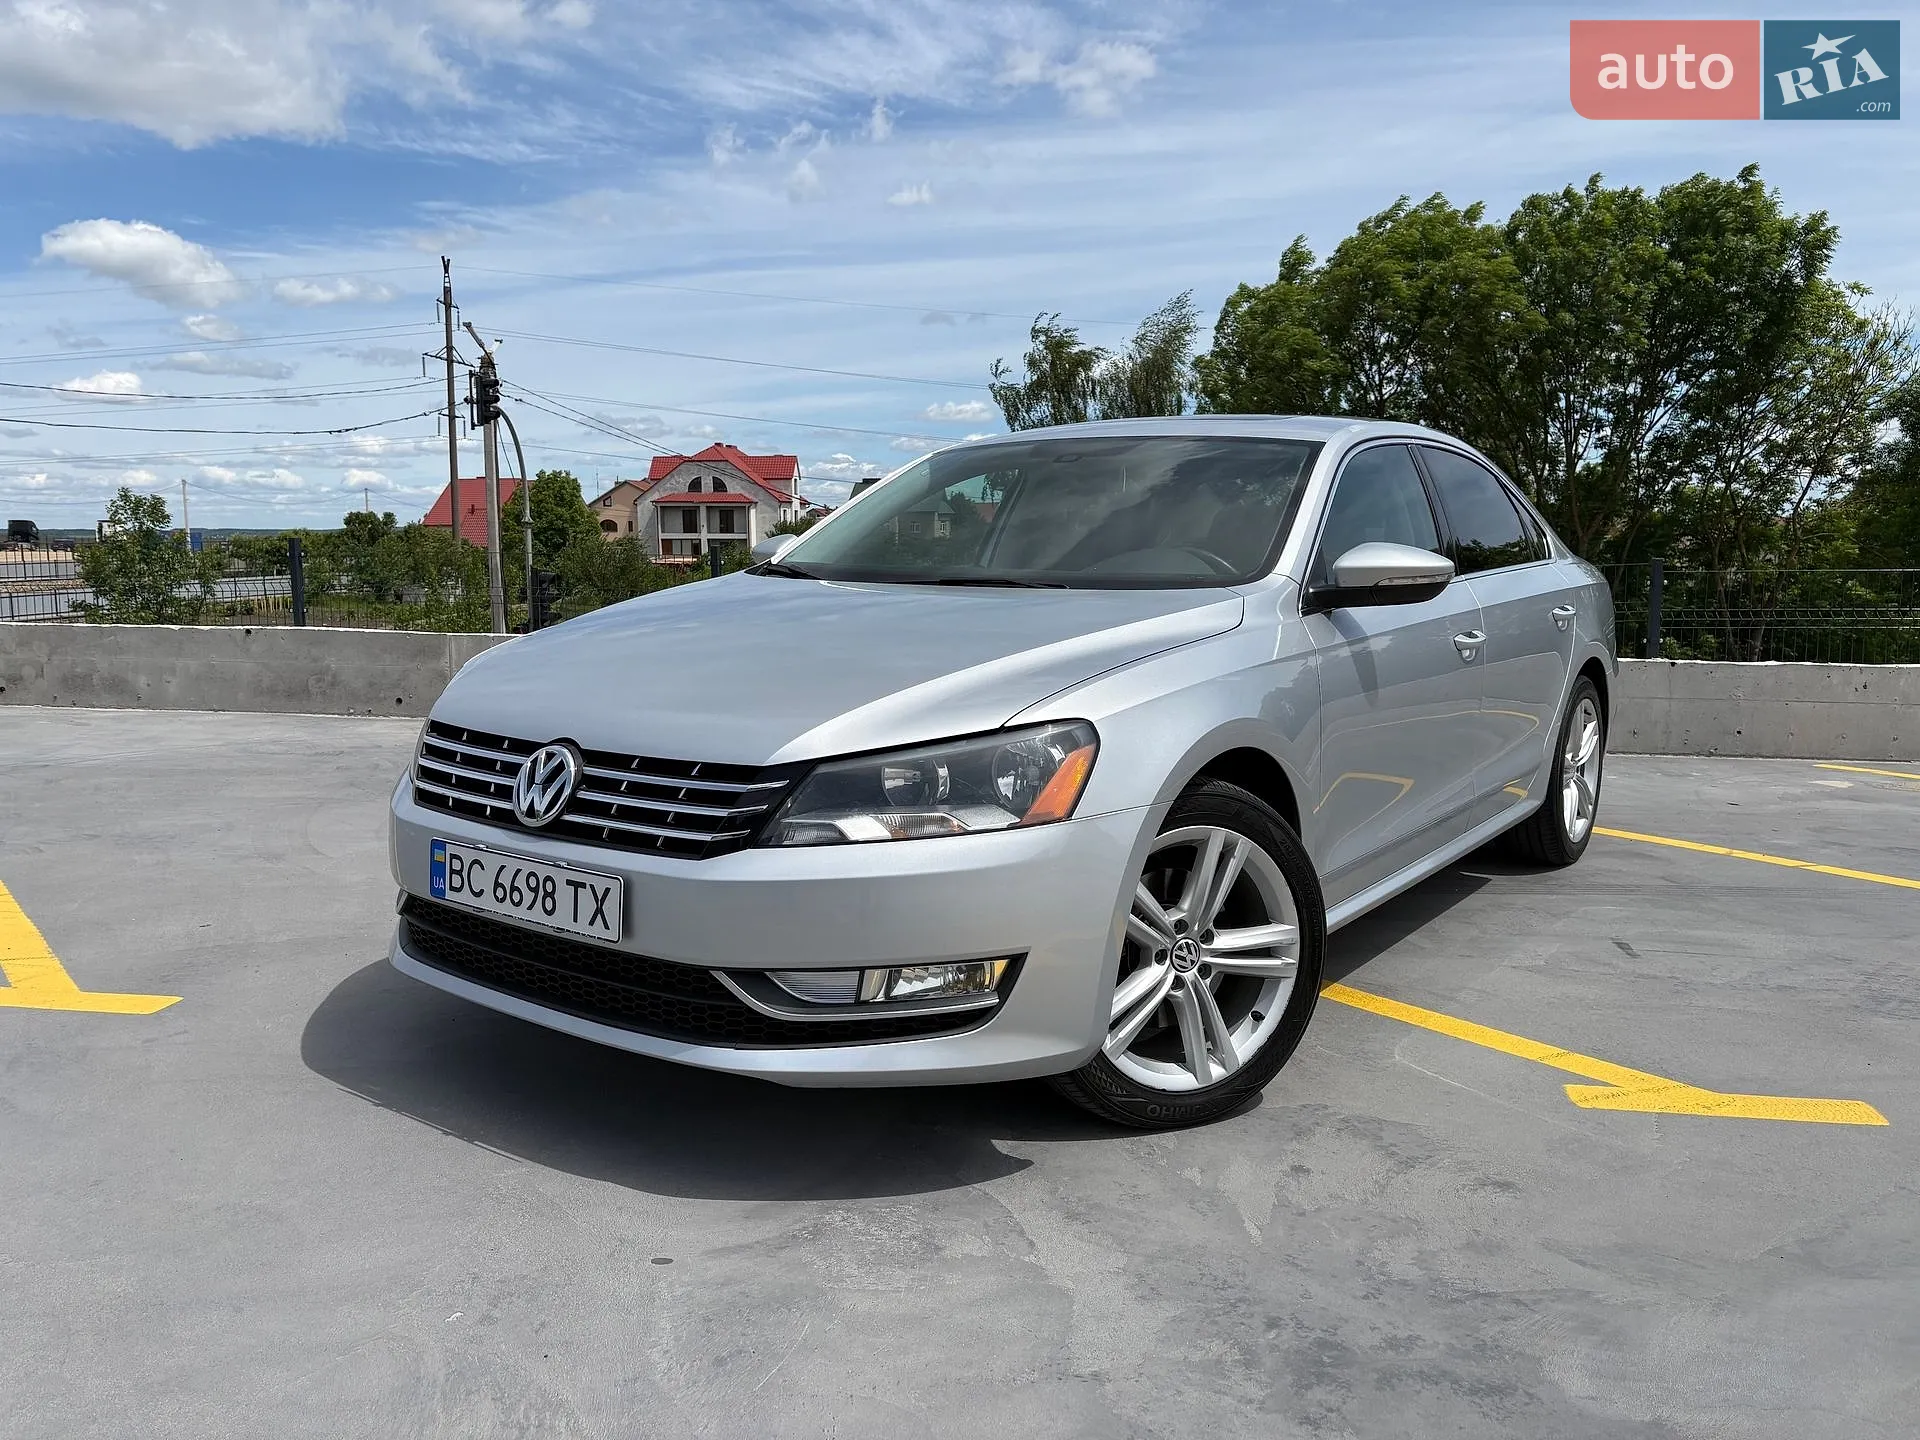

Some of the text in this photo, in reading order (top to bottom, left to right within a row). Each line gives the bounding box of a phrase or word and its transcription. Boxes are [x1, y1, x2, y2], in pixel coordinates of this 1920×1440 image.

[515, 746, 574, 825] VW
[433, 876, 445, 890] UA
[449, 853, 612, 931] BC 6698 TX
